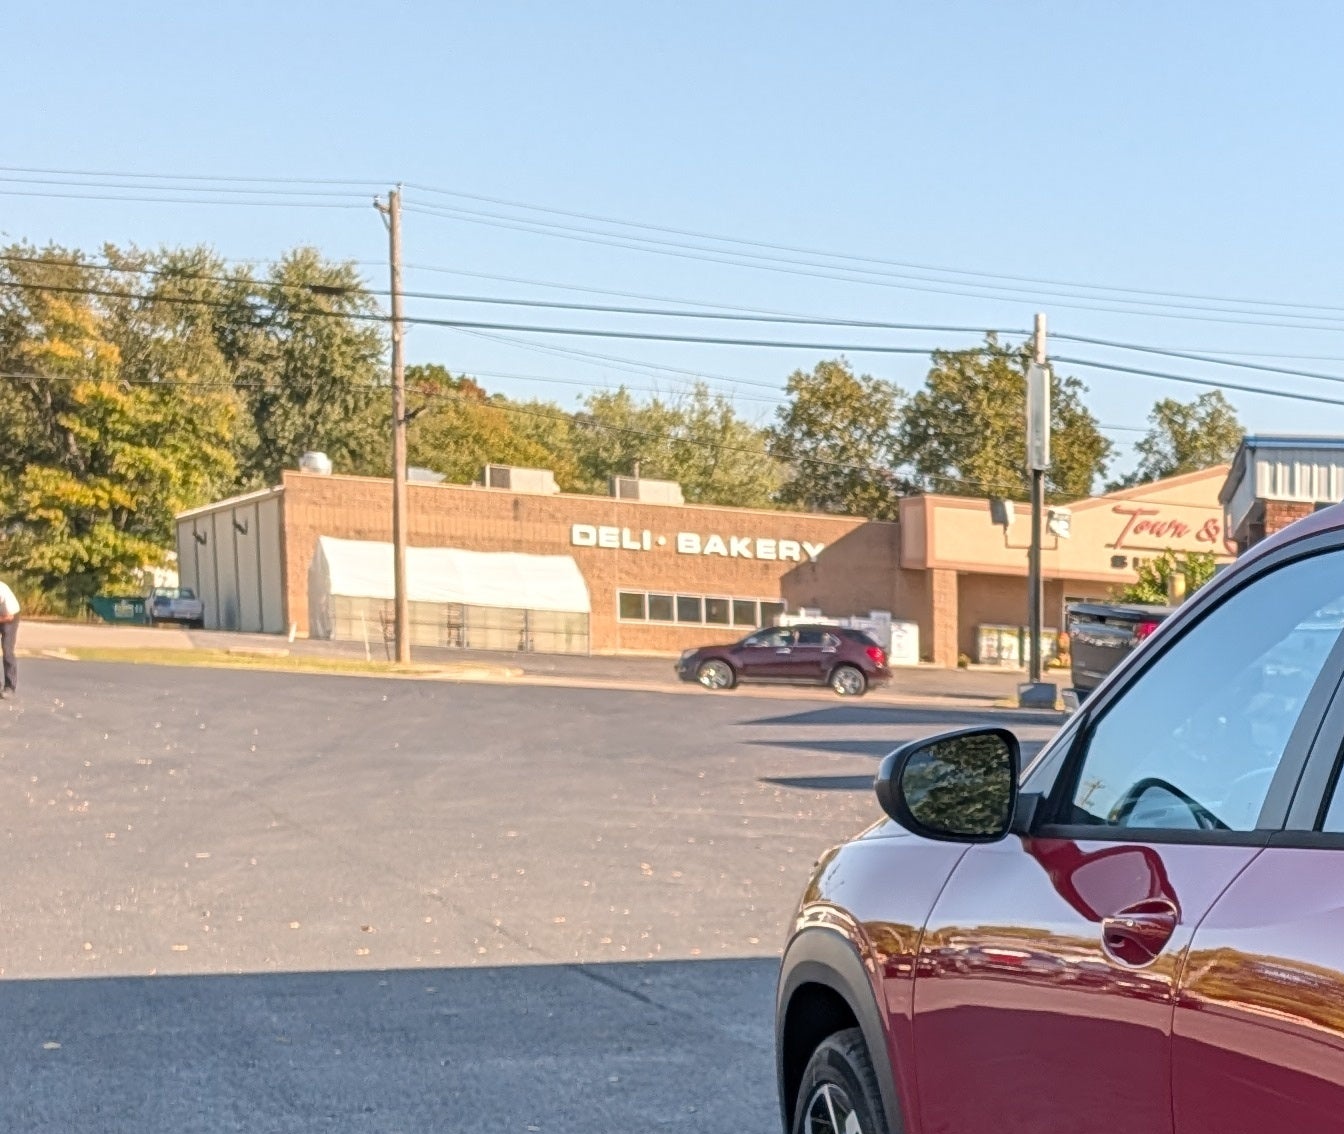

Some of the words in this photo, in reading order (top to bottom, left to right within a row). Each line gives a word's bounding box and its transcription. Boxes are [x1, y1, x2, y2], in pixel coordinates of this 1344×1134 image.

[571, 523, 652, 551] DELI
[676, 531, 826, 563] BAKERY
[1110, 505, 1191, 549] Town
[1195, 518, 1220, 544] &
